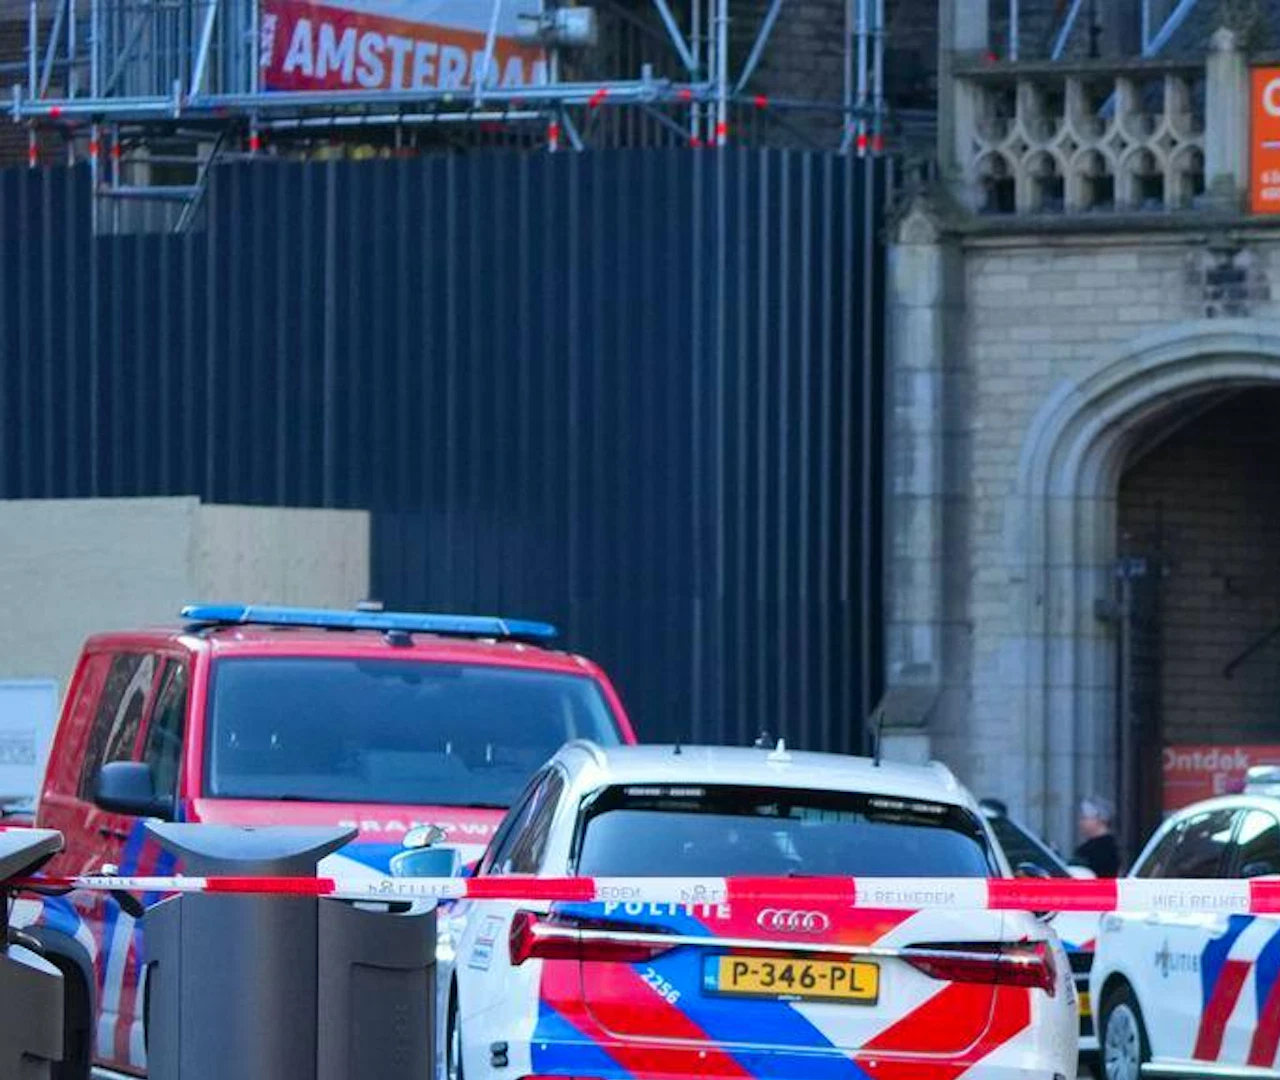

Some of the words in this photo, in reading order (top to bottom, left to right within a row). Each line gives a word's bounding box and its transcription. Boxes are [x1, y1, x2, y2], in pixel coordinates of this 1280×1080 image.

[603, 900, 732, 919] POLITIE
[641, 967, 681, 1004] 2256
[732, 961, 864, 991] P-346-PL
